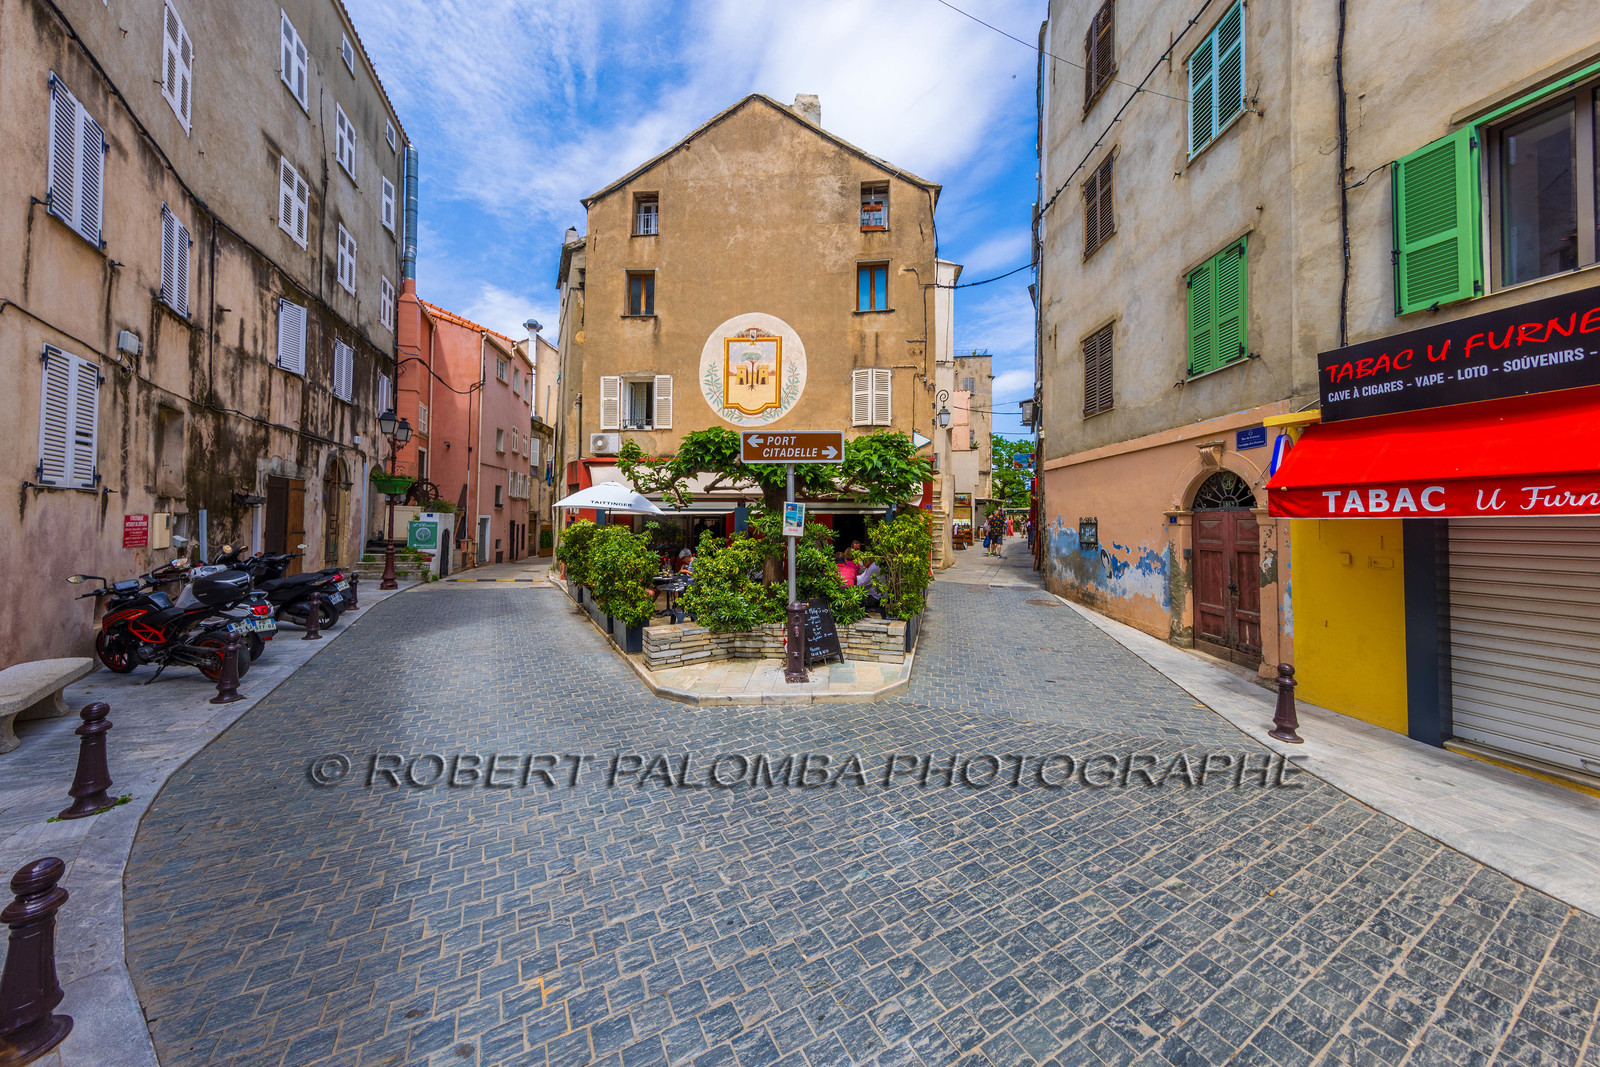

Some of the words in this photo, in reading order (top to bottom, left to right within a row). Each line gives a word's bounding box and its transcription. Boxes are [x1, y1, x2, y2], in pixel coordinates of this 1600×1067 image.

[1325, 348, 1414, 383] TABAC
[1427, 338, 1451, 362] U
[1464, 306, 1600, 358] FURNE
[1328, 389, 1351, 402] CAVE
[1353, 386, 1360, 399] À
[1362, 380, 1404, 397] CIGARES
[1415, 372, 1445, 388] VAPE
[1457, 364, 1488, 381] LOTO
[767, 436, 796, 446] PORT
[762, 447, 818, 458] CITADELLE
[590, 499, 633, 508] TAITTINGER
[1322, 486, 1446, 513] TABAC
[1476, 488, 1506, 511] U
